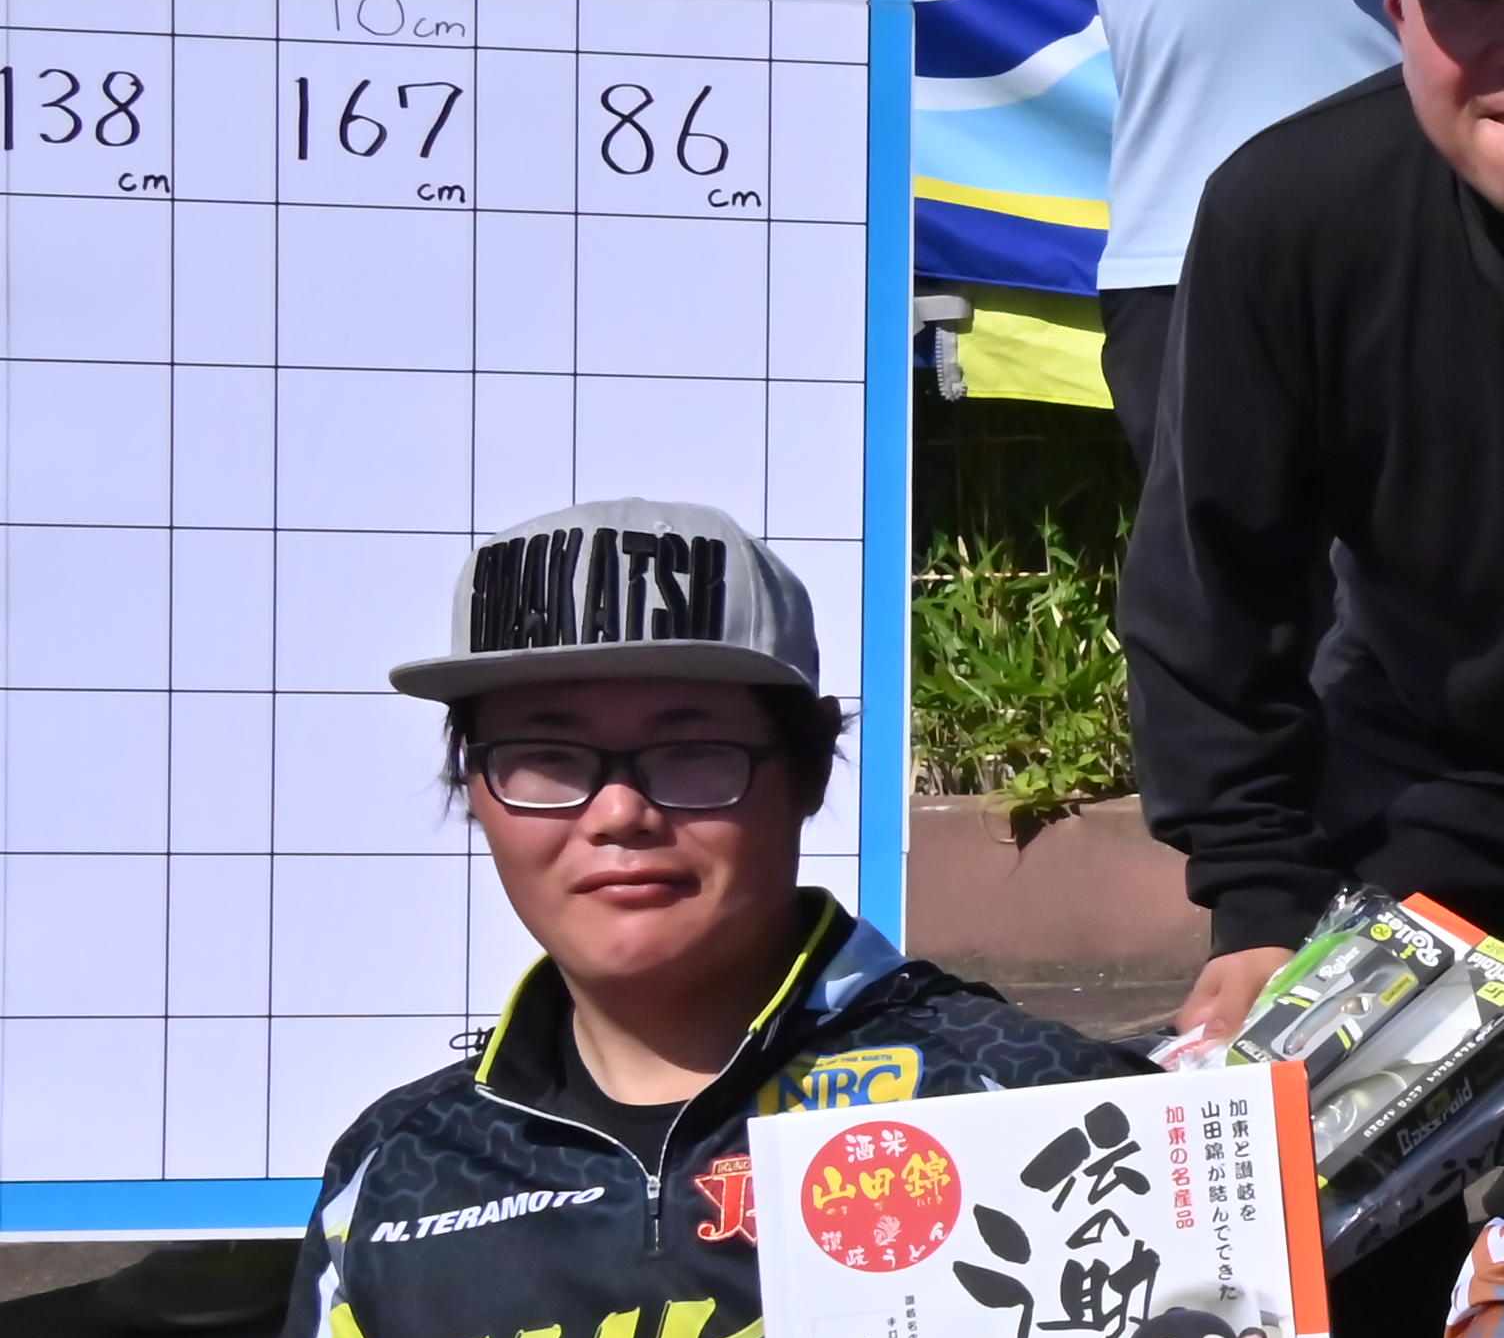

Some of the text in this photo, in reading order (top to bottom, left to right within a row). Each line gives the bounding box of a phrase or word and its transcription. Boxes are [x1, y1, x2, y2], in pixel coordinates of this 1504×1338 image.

[413, 17, 466, 38] cm
[2, 67, 171, 194] 138 cm
[294, 76, 466, 204] 167 cm
[600, 83, 762, 210] 86 cm
[370, 1186, 605, 1243] N.TERAMOTO
